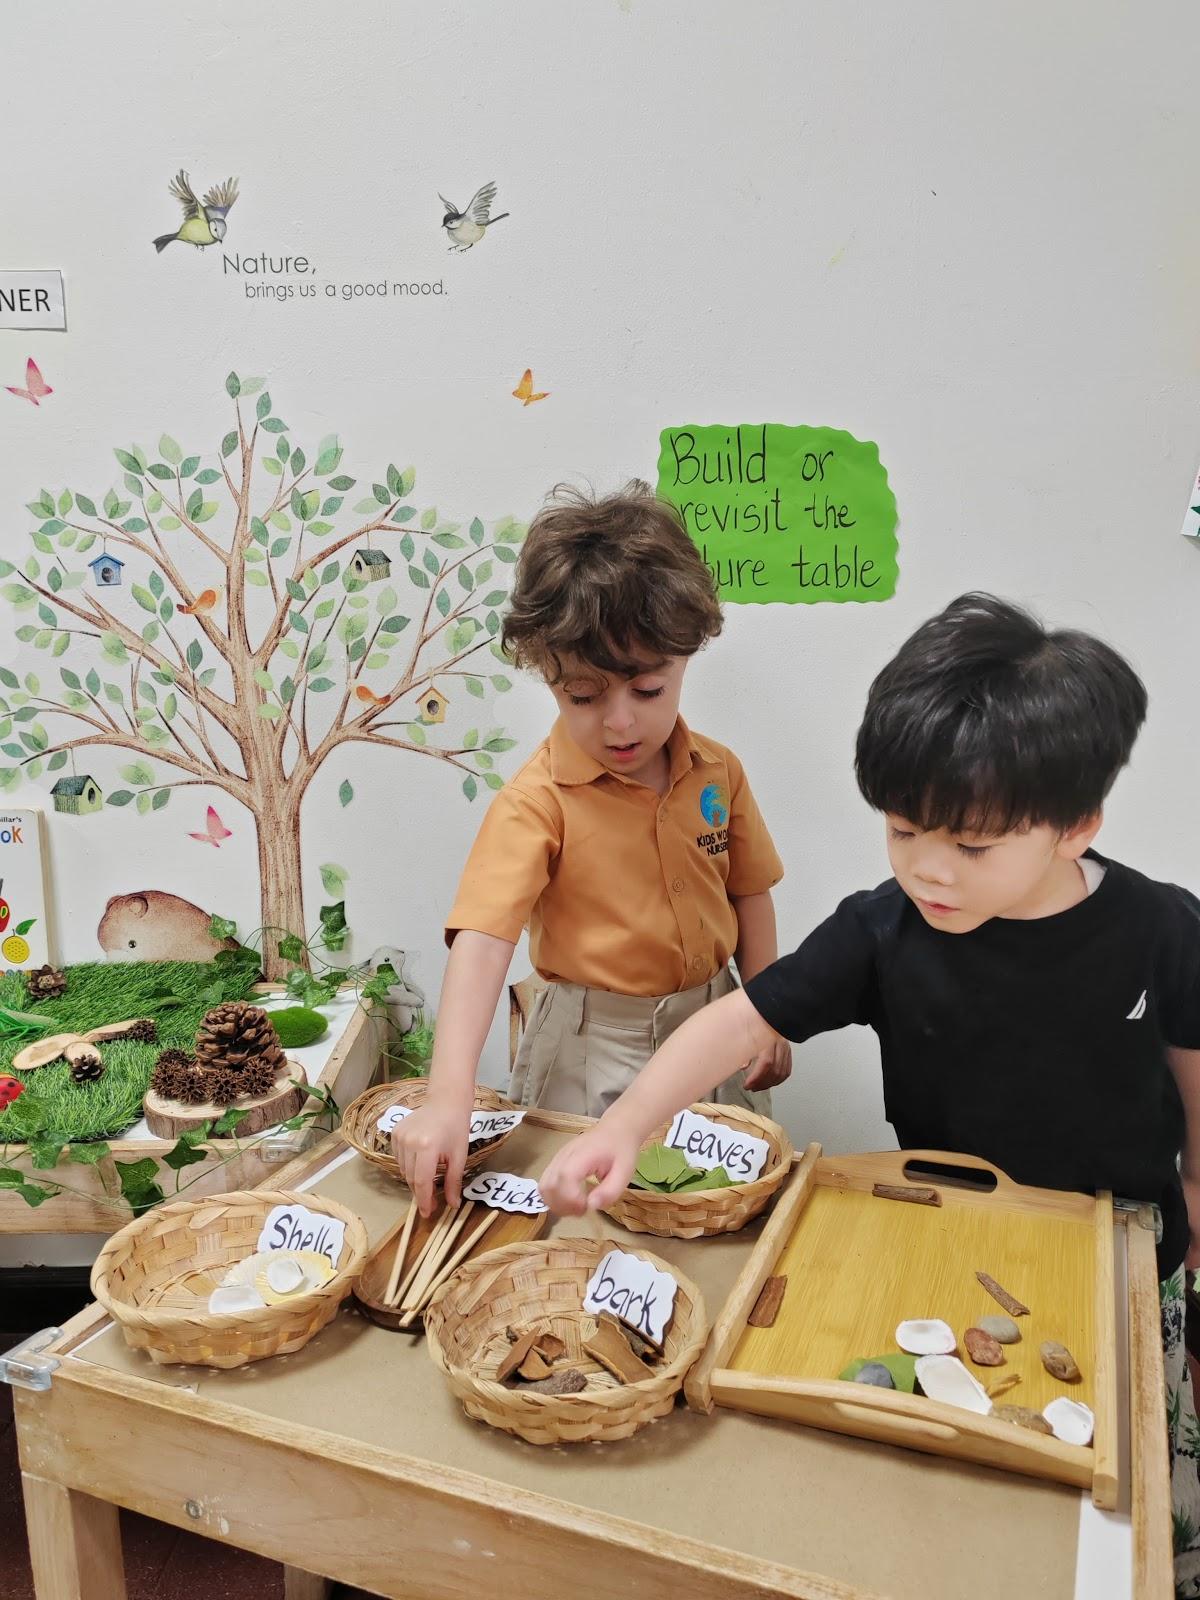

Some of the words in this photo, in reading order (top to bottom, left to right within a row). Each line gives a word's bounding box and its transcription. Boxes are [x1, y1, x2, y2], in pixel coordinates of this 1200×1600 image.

[222, 252, 316, 275] Nature,
[245, 282, 294, 301] brings
[299, 283, 317, 297] us
[325, 284, 336, 297] a
[341, 280, 387, 300] good
[393, 279, 448, 296] mood.
[669, 424, 766, 487] Build
[801, 450, 834, 482] or
[680, 487, 788, 534] revisit
[804, 492, 857, 531] the
[791, 544, 882, 588] table
[696, 832, 716, 848] KIDS
[671, 1113, 755, 1174] Leaves
[591, 1256, 657, 1336] bark
